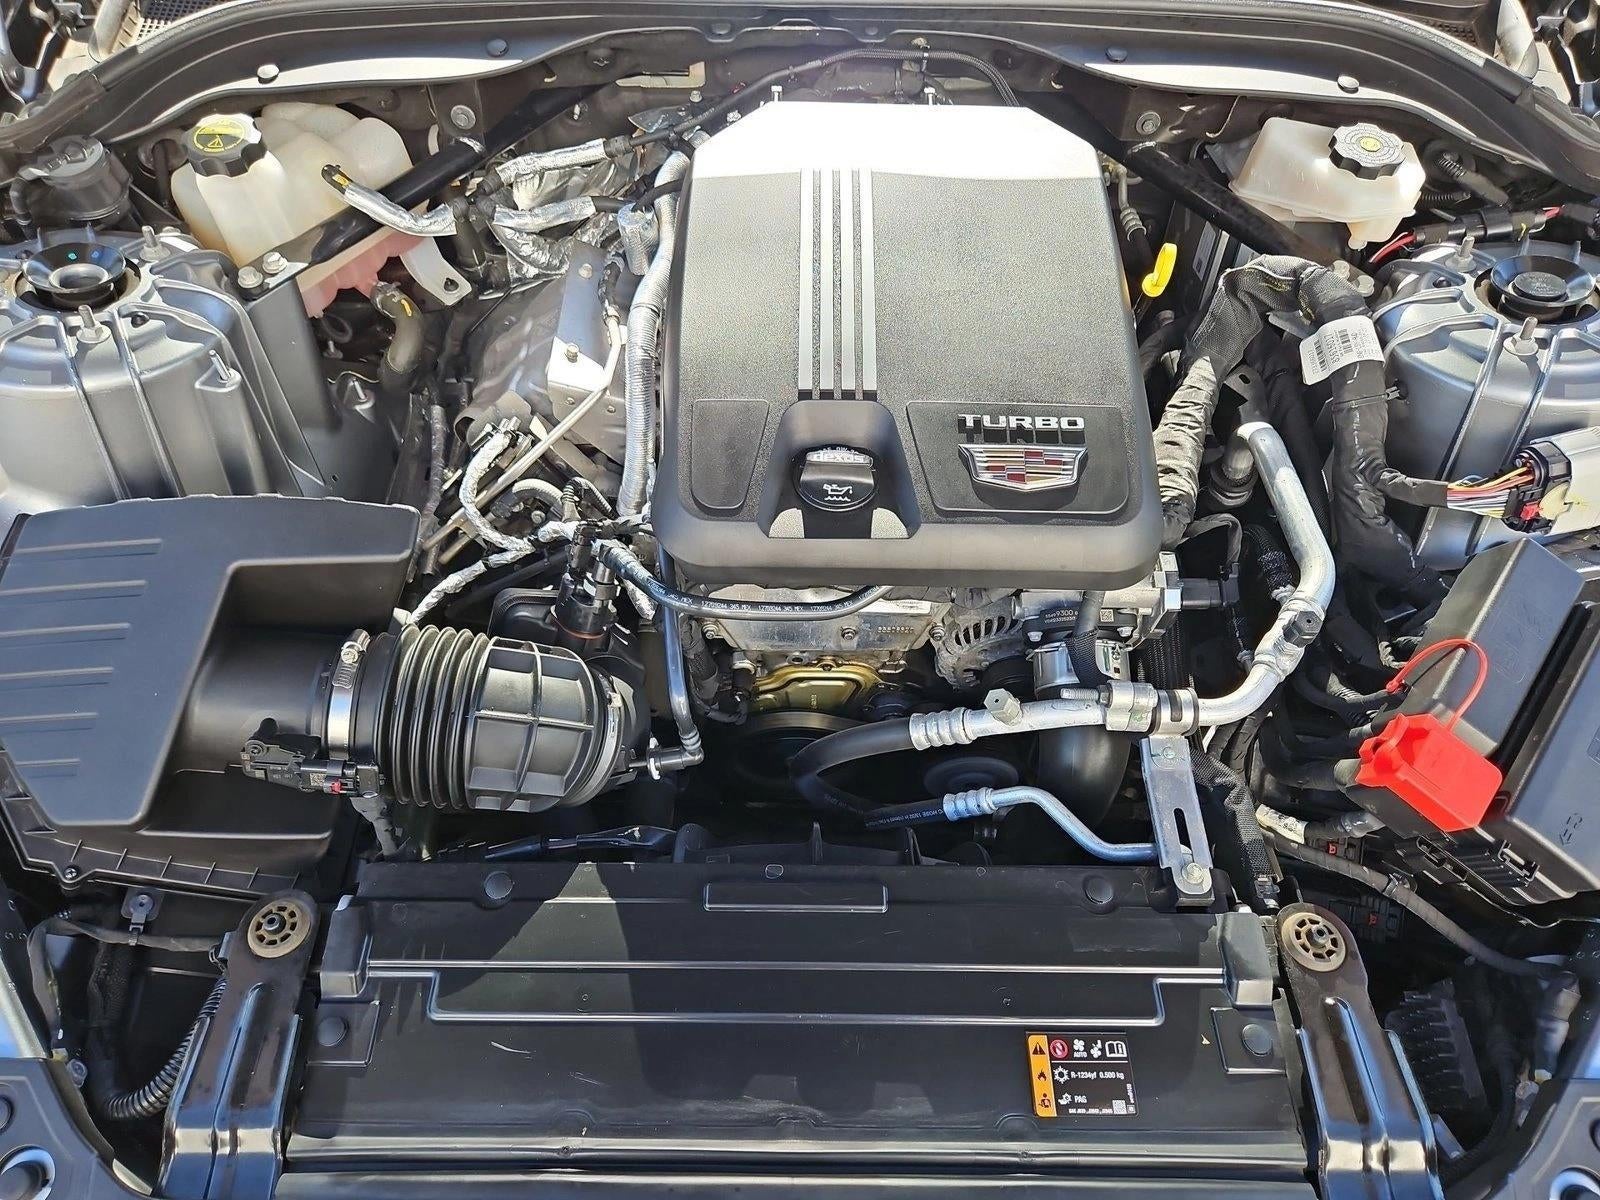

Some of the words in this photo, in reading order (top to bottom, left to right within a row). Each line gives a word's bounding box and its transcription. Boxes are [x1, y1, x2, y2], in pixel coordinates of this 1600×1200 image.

[958, 414, 1085, 430] TURBO
[813, 450, 863, 463] dexos
[1071, 1072, 1096, 1080] R-1234yf
[1099, 1071, 1116, 1079] 0.500
[1116, 1071, 1125, 1080] kg
